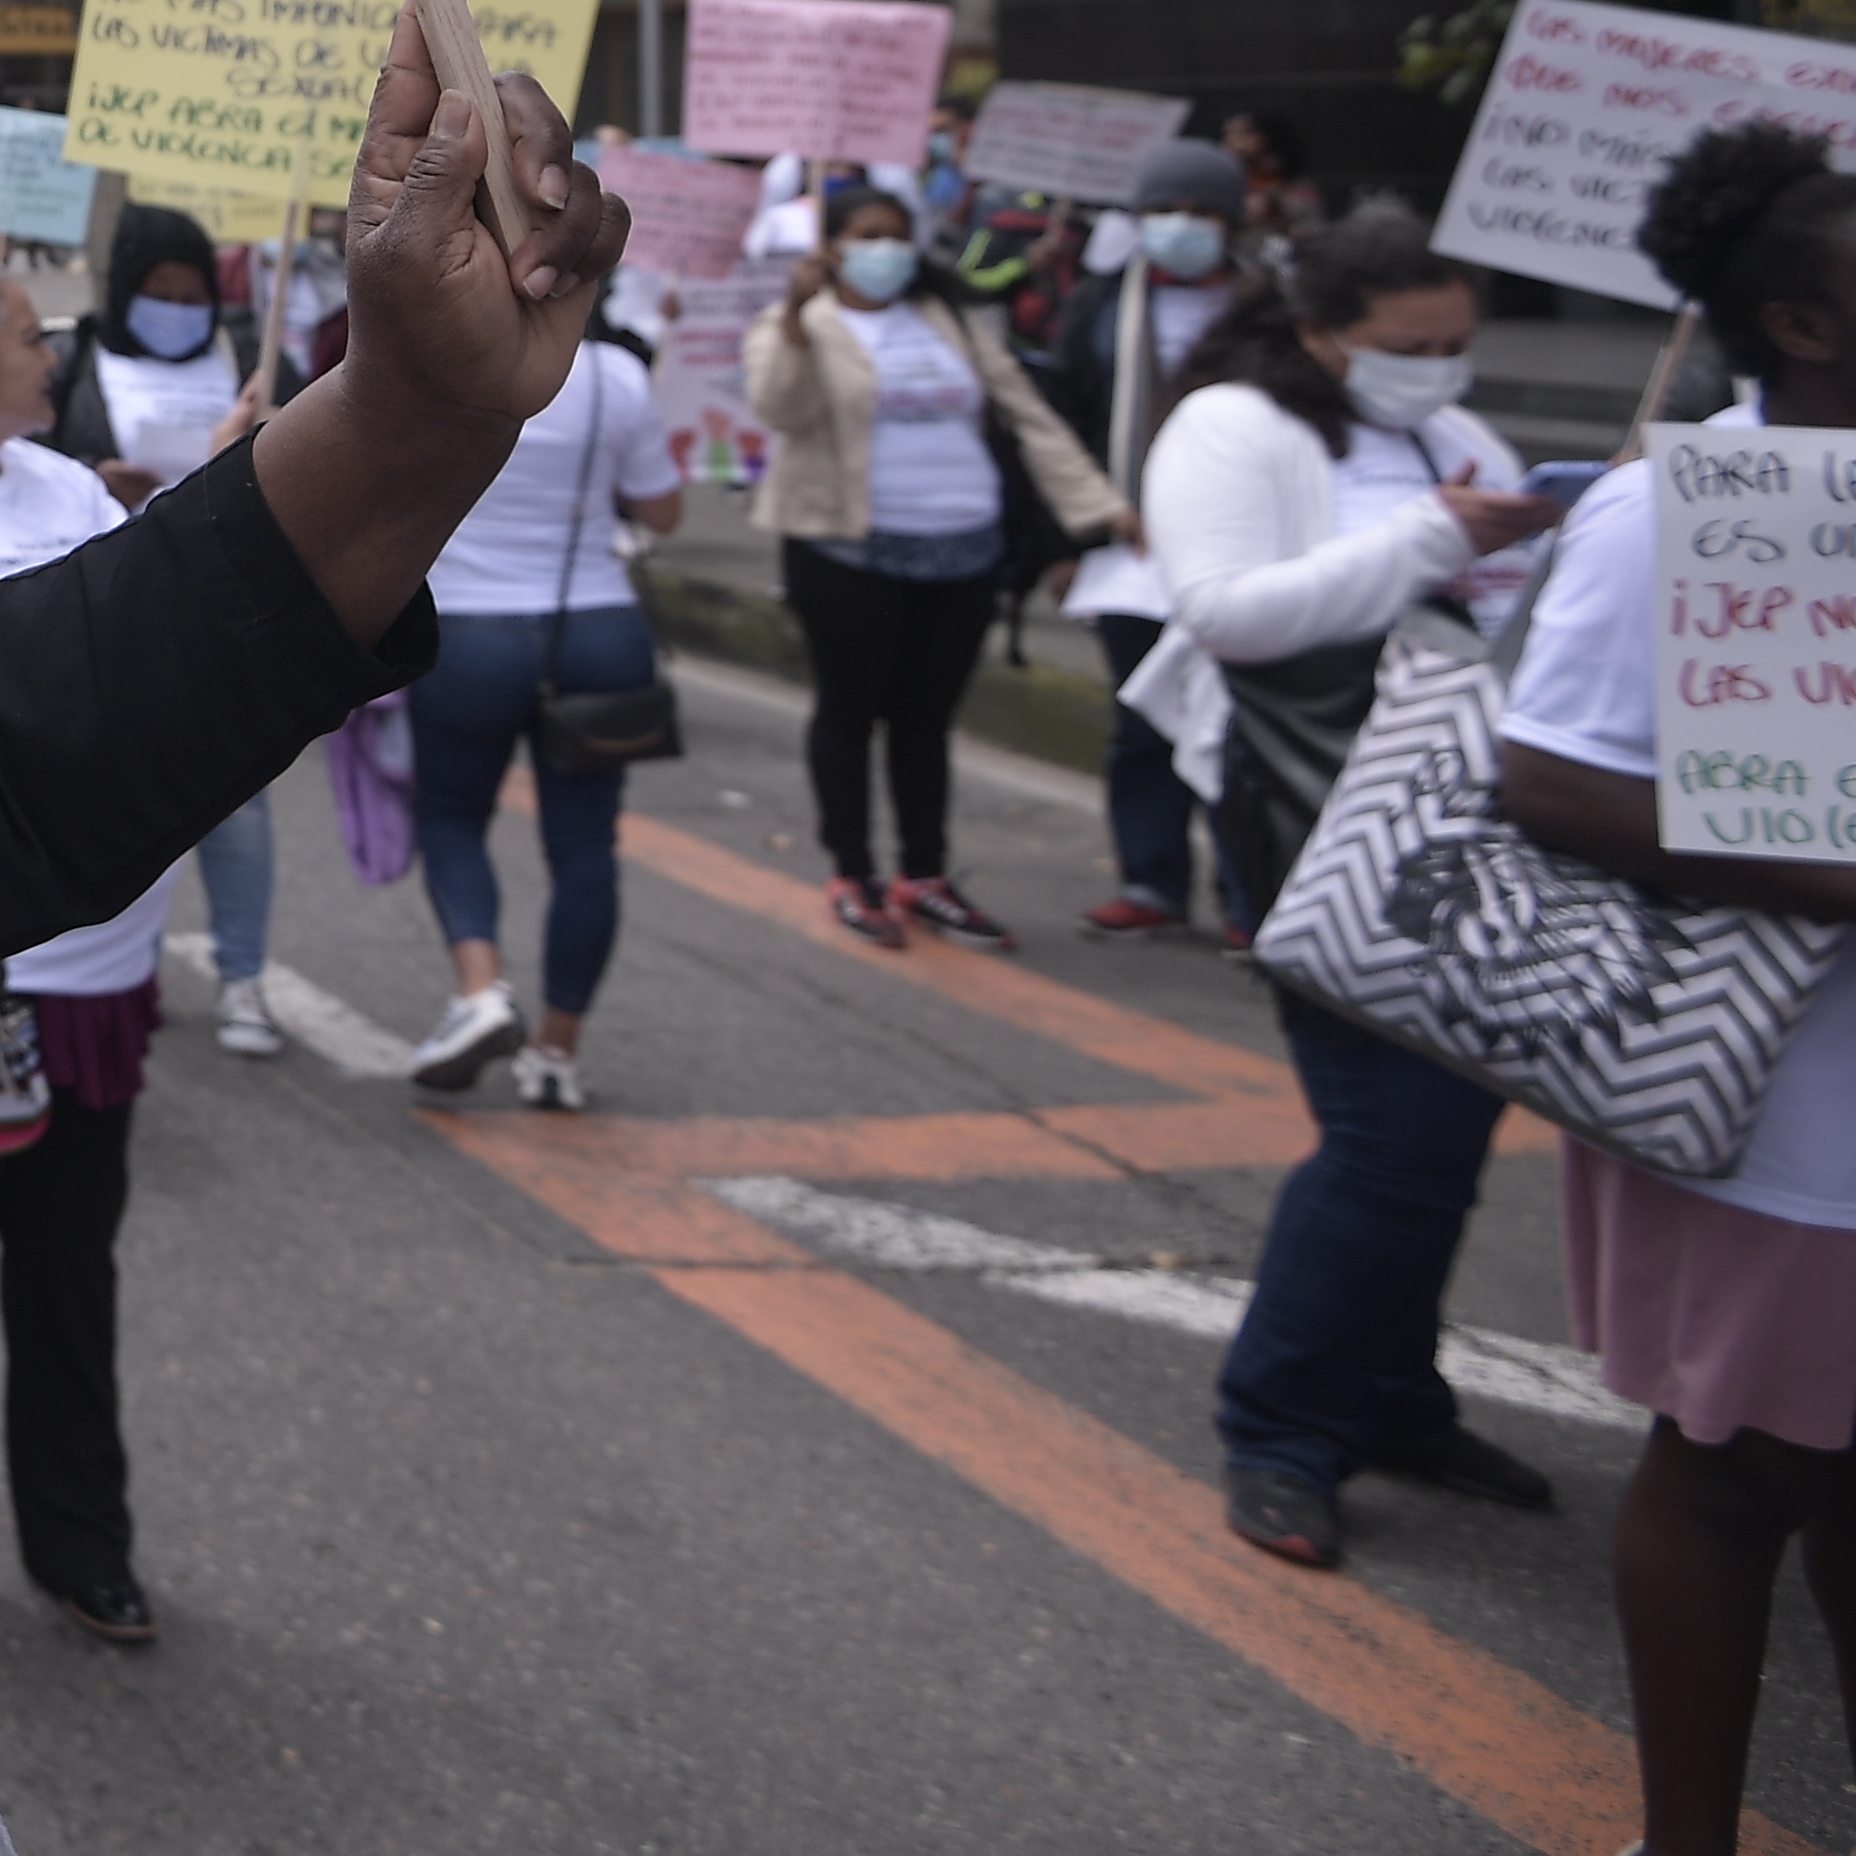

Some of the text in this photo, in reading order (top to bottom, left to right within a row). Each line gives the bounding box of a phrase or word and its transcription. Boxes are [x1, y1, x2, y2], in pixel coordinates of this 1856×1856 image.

[170, 96, 265, 134] ABRA
[1669, 443, 1790, 503] PARA
[1692, 518, 1785, 562] ES
[1678, 658, 1772, 707] LAS
[1675, 749, 1811, 796] ABRA
